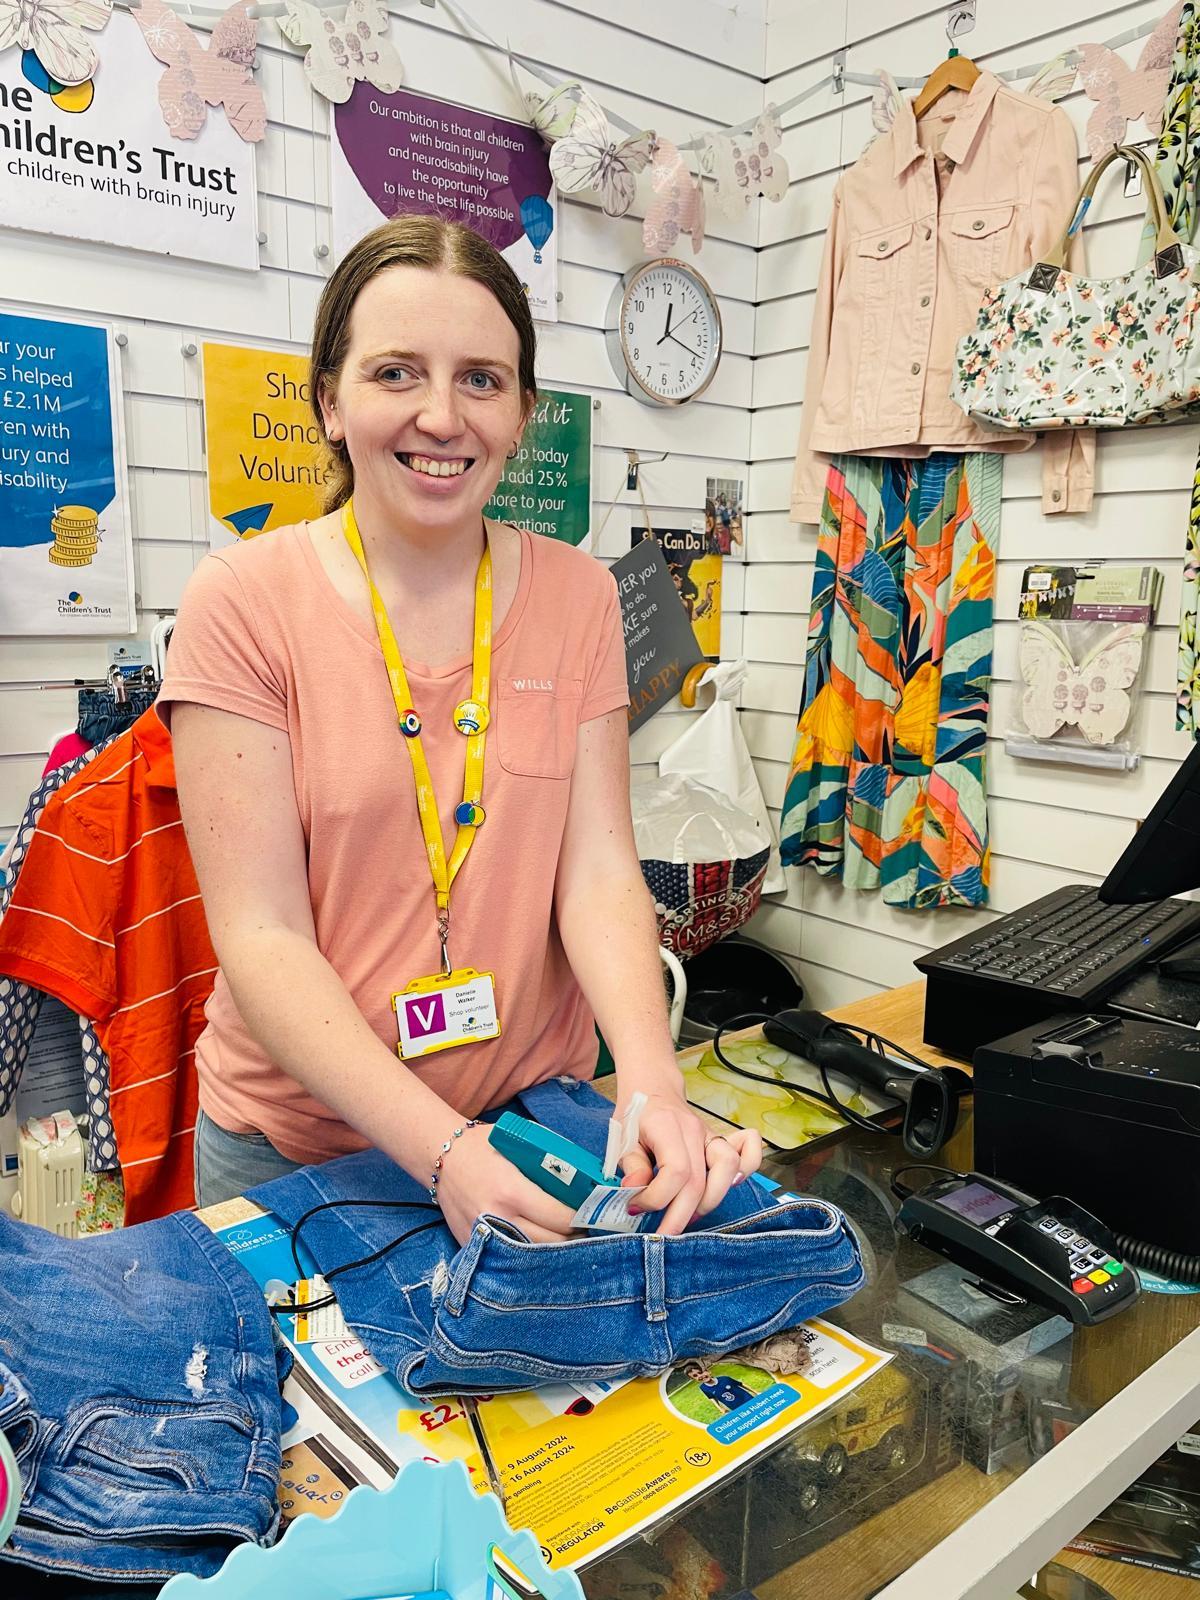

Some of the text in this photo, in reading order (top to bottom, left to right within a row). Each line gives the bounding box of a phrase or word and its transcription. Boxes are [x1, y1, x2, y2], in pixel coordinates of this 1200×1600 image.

[369, 99, 524, 153] Our ambition is that all children
[410, 132, 490, 164] with brain injury
[152, 147, 238, 195] Trust
[388, 145, 509, 185] and neurodisability have
[7, 157, 235, 221] children with brain injury
[412, 168, 489, 200] the opportunity
[383, 181, 514, 222] to live the best life possible
[645, 286, 655, 299] 11
[663, 282, 673, 296] 12
[681, 292, 686, 304] 1
[634, 300, 645, 313] 10
[692, 311, 698, 324] 2
[628, 322, 634, 334] 9
[696, 334, 702, 347] 3
[15, 343, 56, 361] your
[633, 348, 640, 360] 8
[646, 365, 652, 378] 7
[690, 357, 696, 368] 4
[12, 364, 73, 389] helped
[661, 373, 667, 386] 6
[679, 370, 685, 383] 5
[3, 390, 61, 413] £2.1M
[553, 401, 573, 425] it
[31, 422, 70, 439] with
[35, 448, 70, 465] and
[532, 447, 569, 468] today
[508, 469, 534, 485] add
[537, 470, 568, 488] 25%
[521, 494, 535, 509] to
[537, 498, 566, 514] your
[664, 532, 684, 550] Can
[685, 533, 700, 550] Do
[57, 606, 112, 614] Children's Trust
[626, 600, 635, 612] to
[623, 603, 658, 638] KE sure
[628, 625, 650, 648] makes
[633, 647, 656, 684] you
[513, 680, 553, 690] WILLS
[686, 911, 732, 943] M&S
[458, 996, 476, 1004] Walker
[412, 1001, 437, 1032] V
[448, 1004, 490, 1018] Shop volunteer
[349, 1362, 374, 1380] call
[714, 1388, 785, 1434] Children like Hubert need
[723, 1398, 786, 1442] your support right now
[507, 1461, 515, 1471] 9
[516, 1446, 547, 1468] August
[545, 1435, 568, 1451] 2024
[689, 1450, 709, 1465] 18+
[510, 1473, 524, 1485] 16
[523, 1456, 554, 1478] August
[552, 1443, 576, 1461] 2024
[513, 1478, 542, 1499] gambling
[604, 1463, 683, 1516] BeGambleAware.org
[550, 1517, 600, 1549] FUNDRAISING
[556, 1520, 606, 1555] REGULATOR
